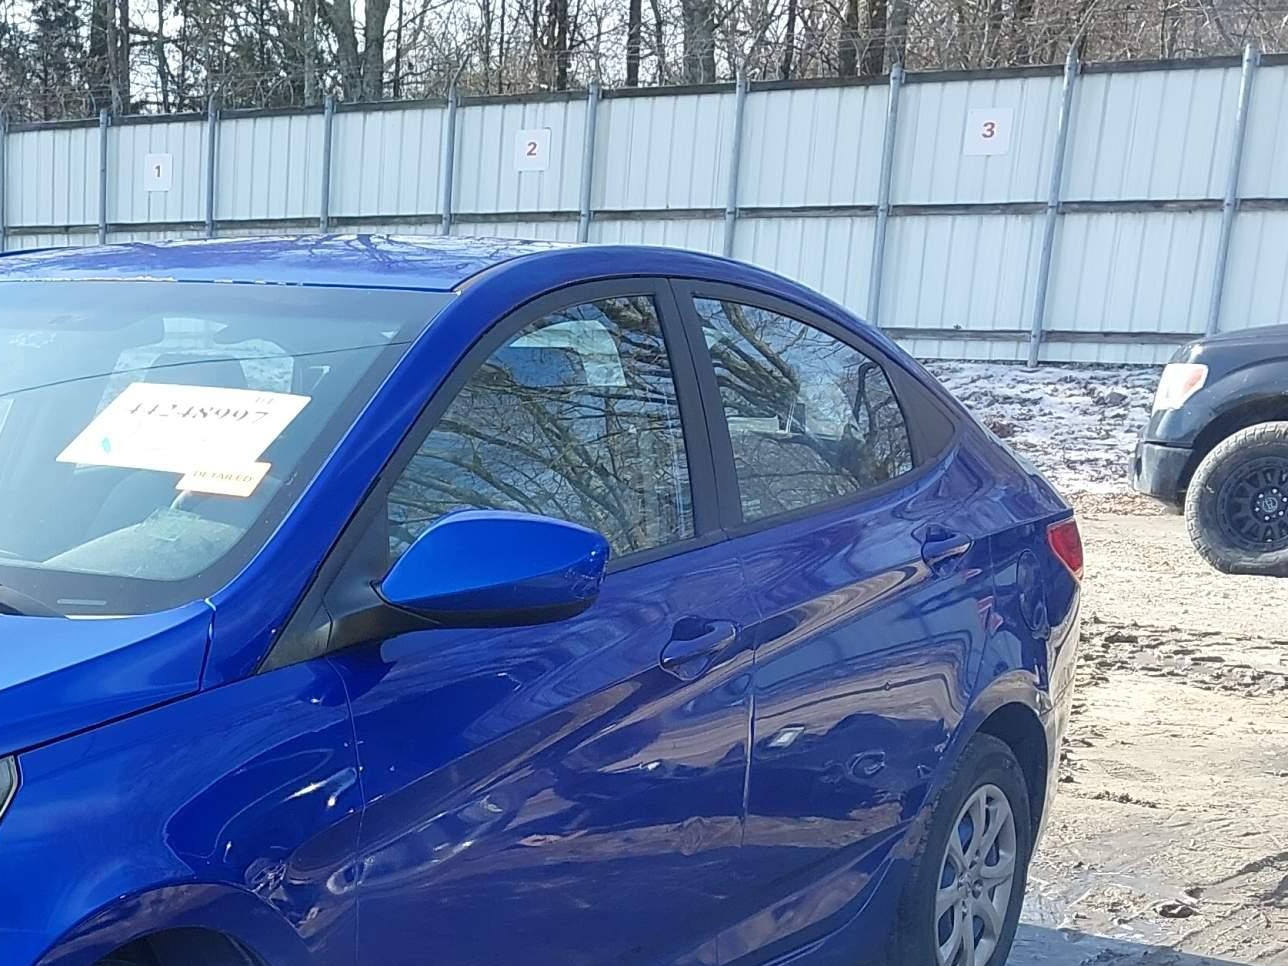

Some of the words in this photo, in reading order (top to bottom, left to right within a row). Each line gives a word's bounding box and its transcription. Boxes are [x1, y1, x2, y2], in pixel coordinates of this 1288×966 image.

[981, 121, 996, 139] 3
[526, 141, 537, 157] 2
[154, 164, 161, 178] 1
